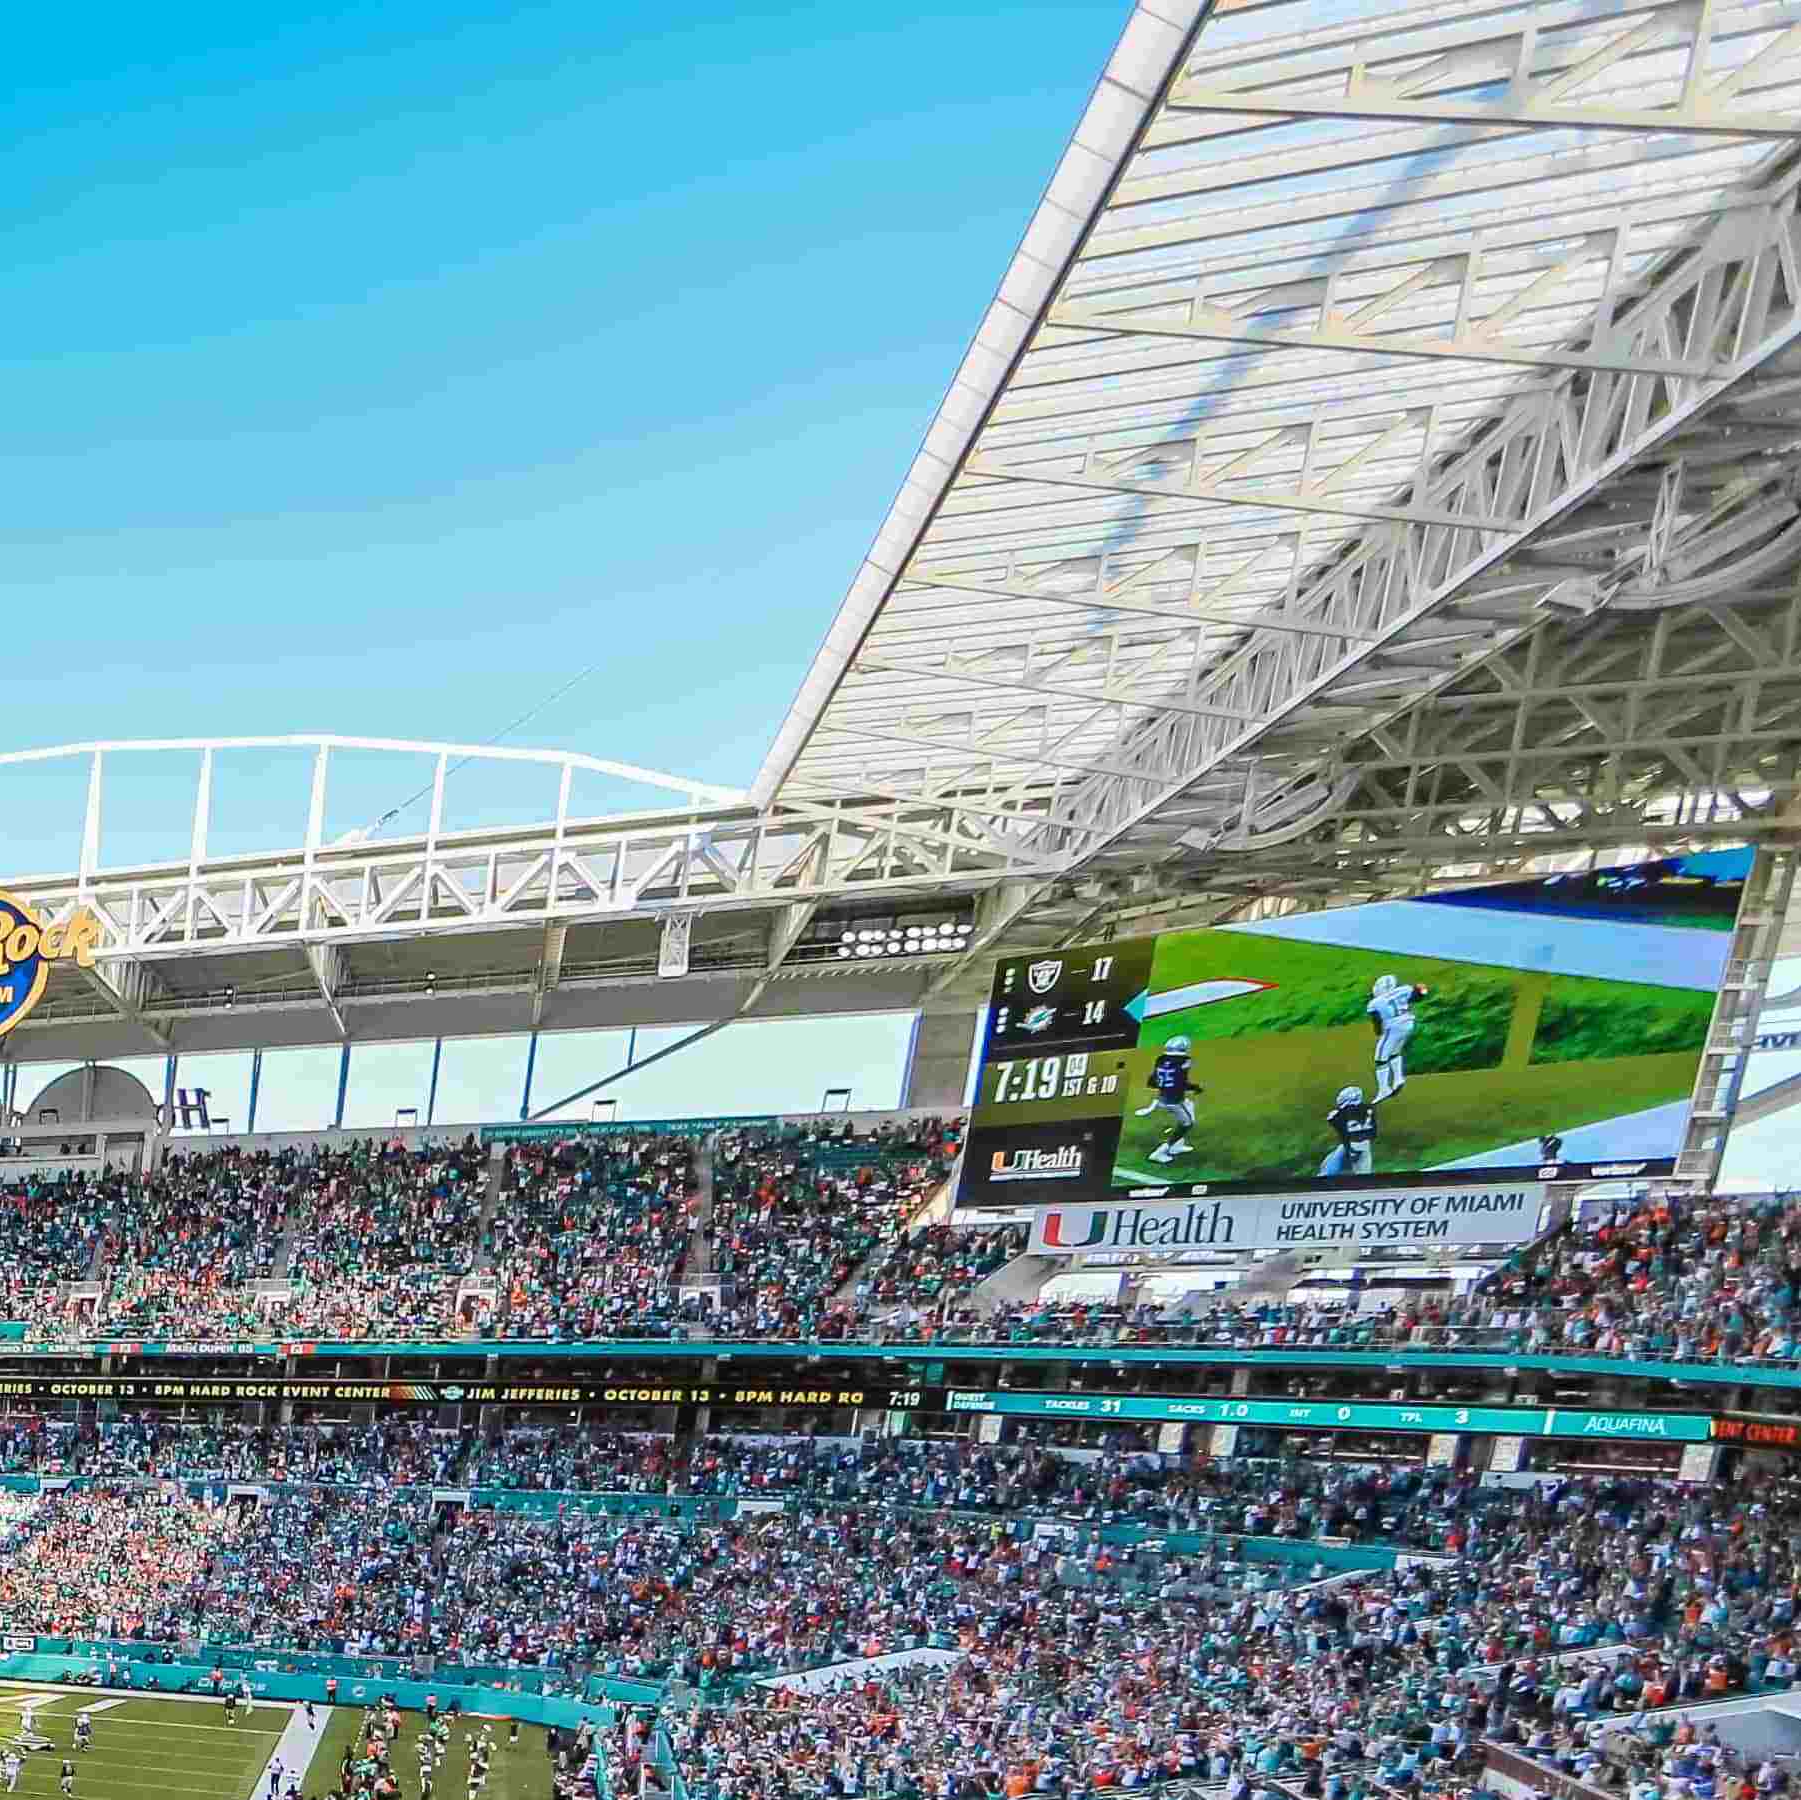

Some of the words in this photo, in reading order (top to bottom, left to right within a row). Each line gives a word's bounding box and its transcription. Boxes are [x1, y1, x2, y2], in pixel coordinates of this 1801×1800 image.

[1091, 956, 1113, 981] 17
[1082, 1000, 1105, 1024] 14
[995, 1056, 1060, 1103] 7:19
[1280, 1198, 1405, 1220] UNIVERSITY
[1409, 1196, 1438, 1216] OF
[1444, 1192, 1524, 1214] MIAMI
[1276, 1222, 1354, 1241] HEALTH
[1359, 1219, 1449, 1239] SYSTEM
[51, 1384, 113, 1395] OCTOBER
[119, 1385, 135, 1395] 13
[154, 1386, 185, 1396] 8PM
[190, 1386, 231, 1397] HARD
[237, 1386, 278, 1397] ROCK
[283, 1387, 330, 1398] EVENT
[335, 1387, 391, 1398] CENTER
[467, 1388, 496, 1399] JIM
[501, 1388, 580, 1400] JEFFERIES
[605, 1389, 683, 1401] OCTOBER
[692, 1389, 710, 1401] 13
[734, 1391, 773, 1403] 8PM
[780, 1391, 831, 1404] HARD
[889, 1392, 920, 1406] 7:19
[1045, 1399, 1089, 1410] TACKLES
[1101, 1399, 1121, 1413] 31
[1167, 1404, 1206, 1414] SACKS
[1220, 1404, 1248, 1417] 1.0
[1338, 1407, 1351, 1420] 0
[1455, 1409, 1469, 1424] 3
[1583, 1416, 1667, 1435] AQUAFINA
